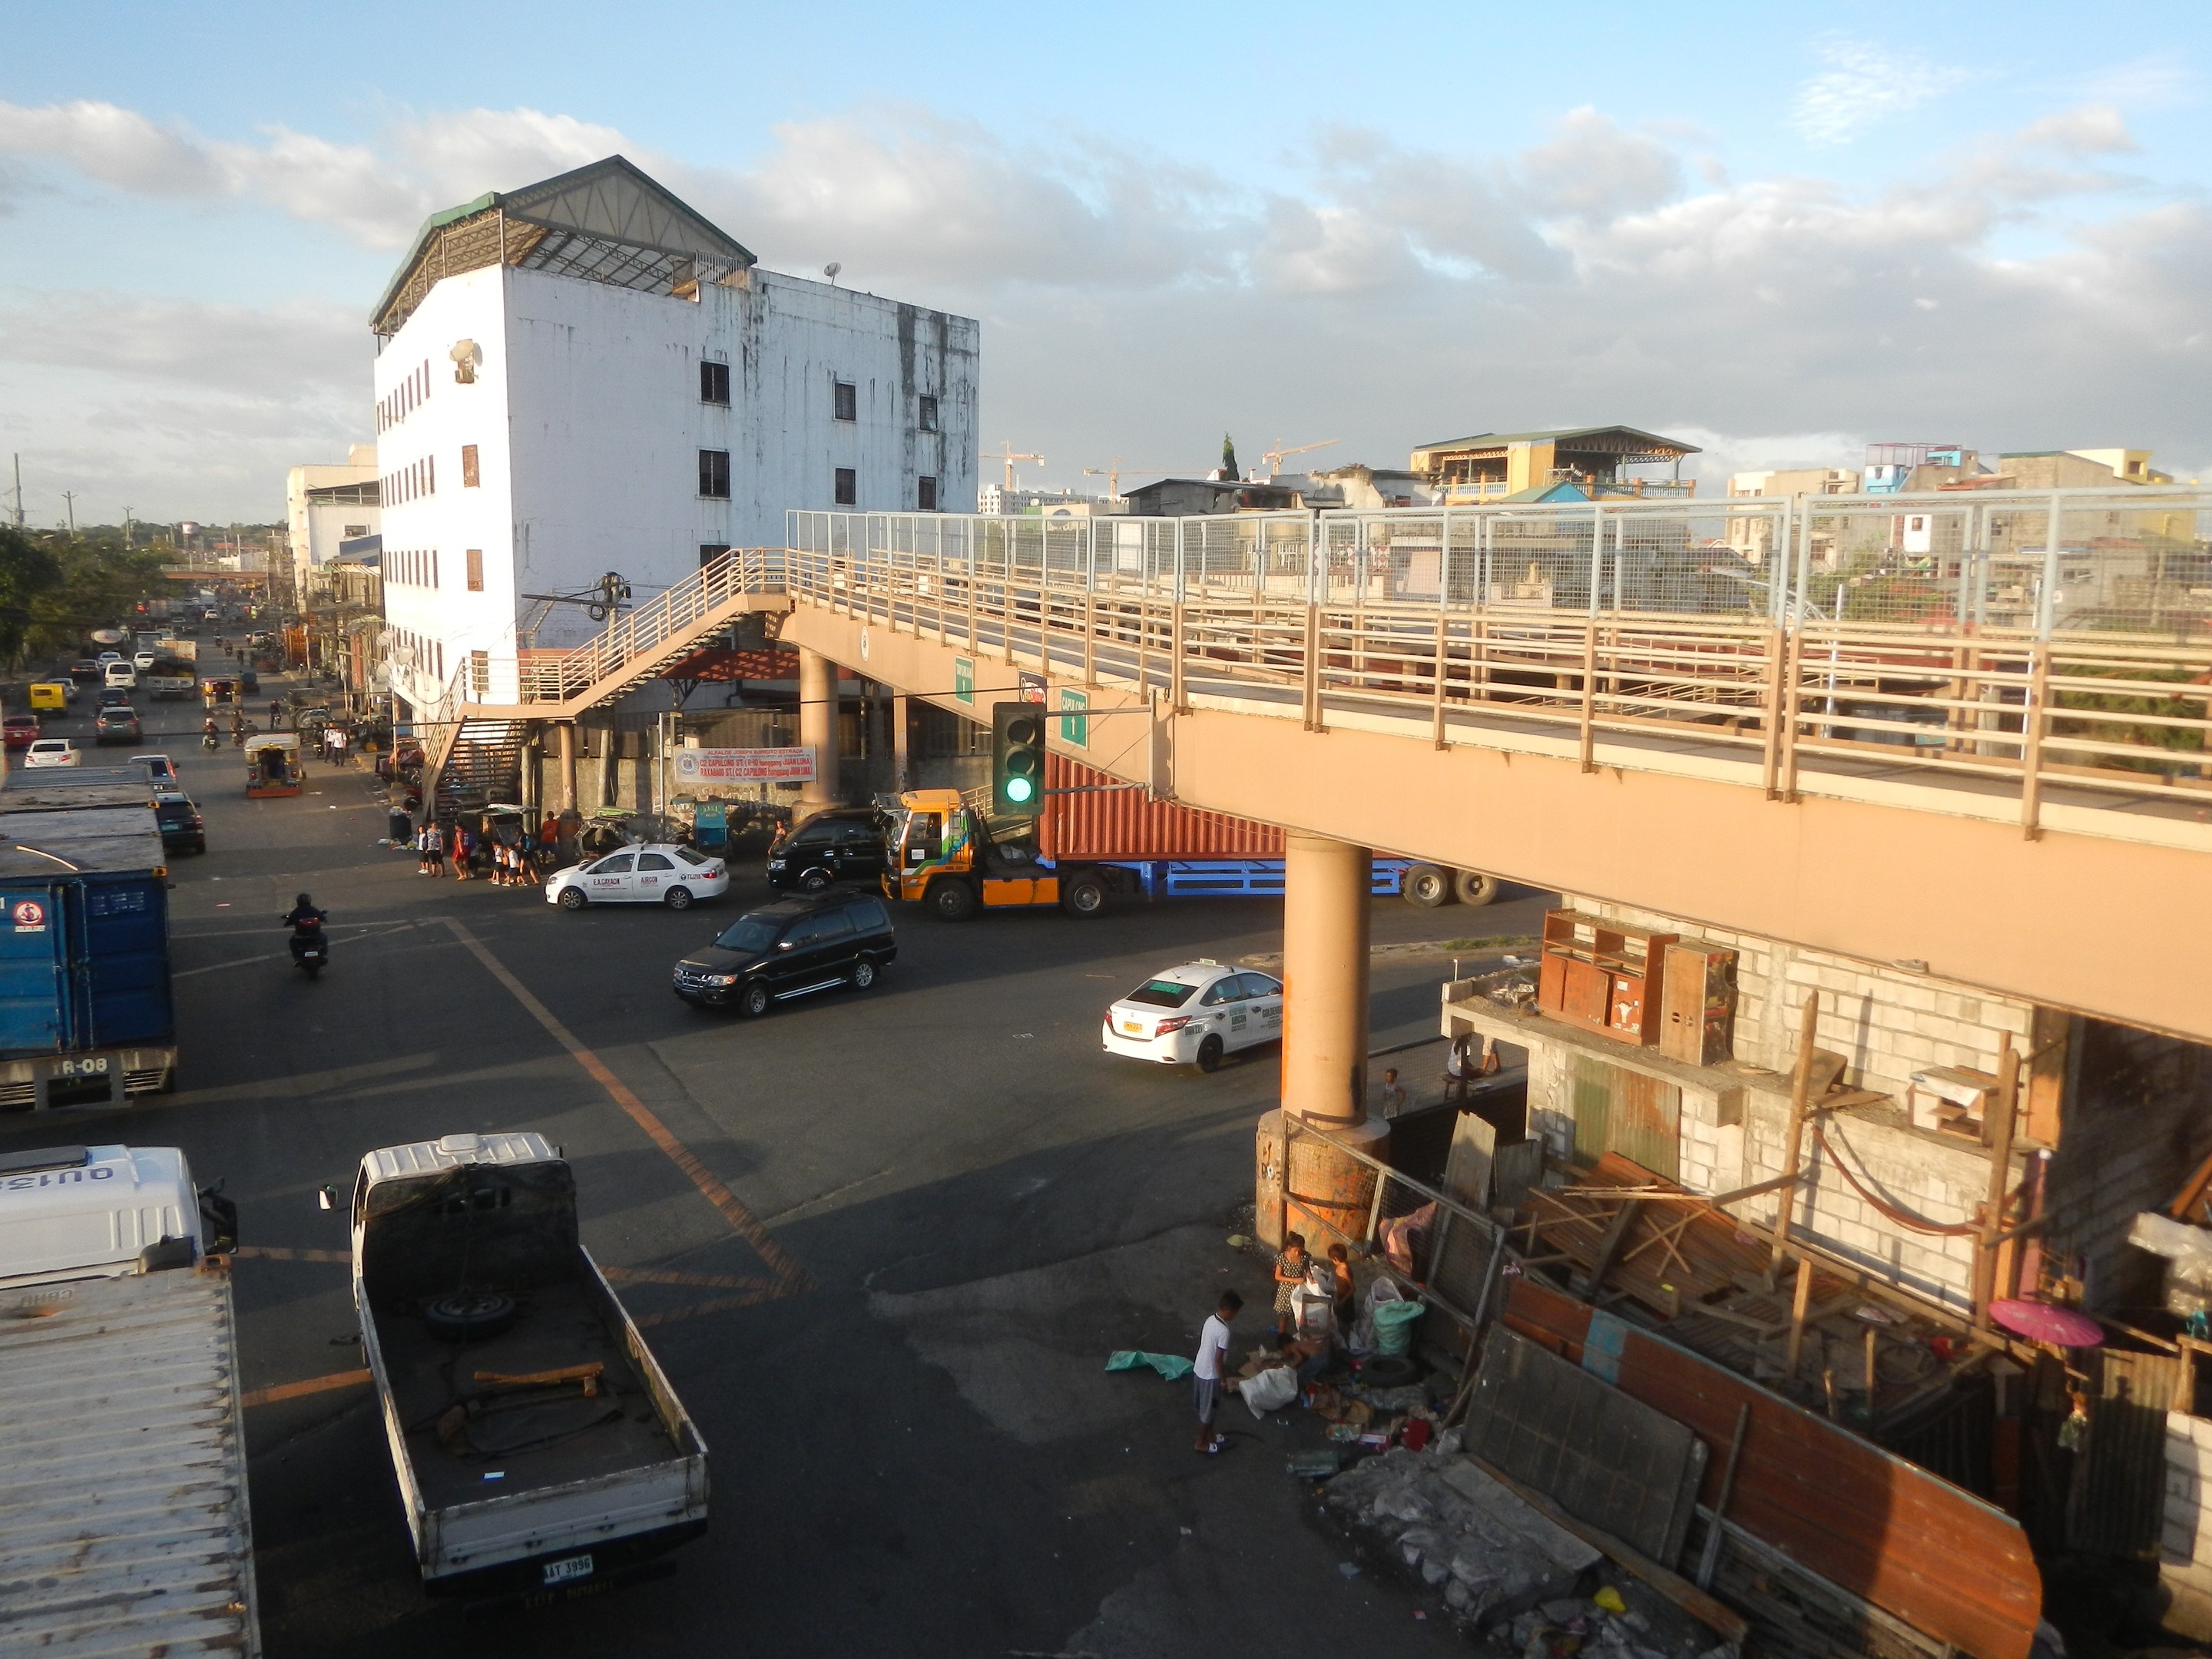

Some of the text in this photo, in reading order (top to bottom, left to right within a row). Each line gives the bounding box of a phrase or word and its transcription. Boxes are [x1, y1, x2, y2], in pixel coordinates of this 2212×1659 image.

[1061, 696, 1086, 716] CAPULONG
[0, 1167, 114, 1190] QU13
[566, 1557, 591, 1574] 3996
